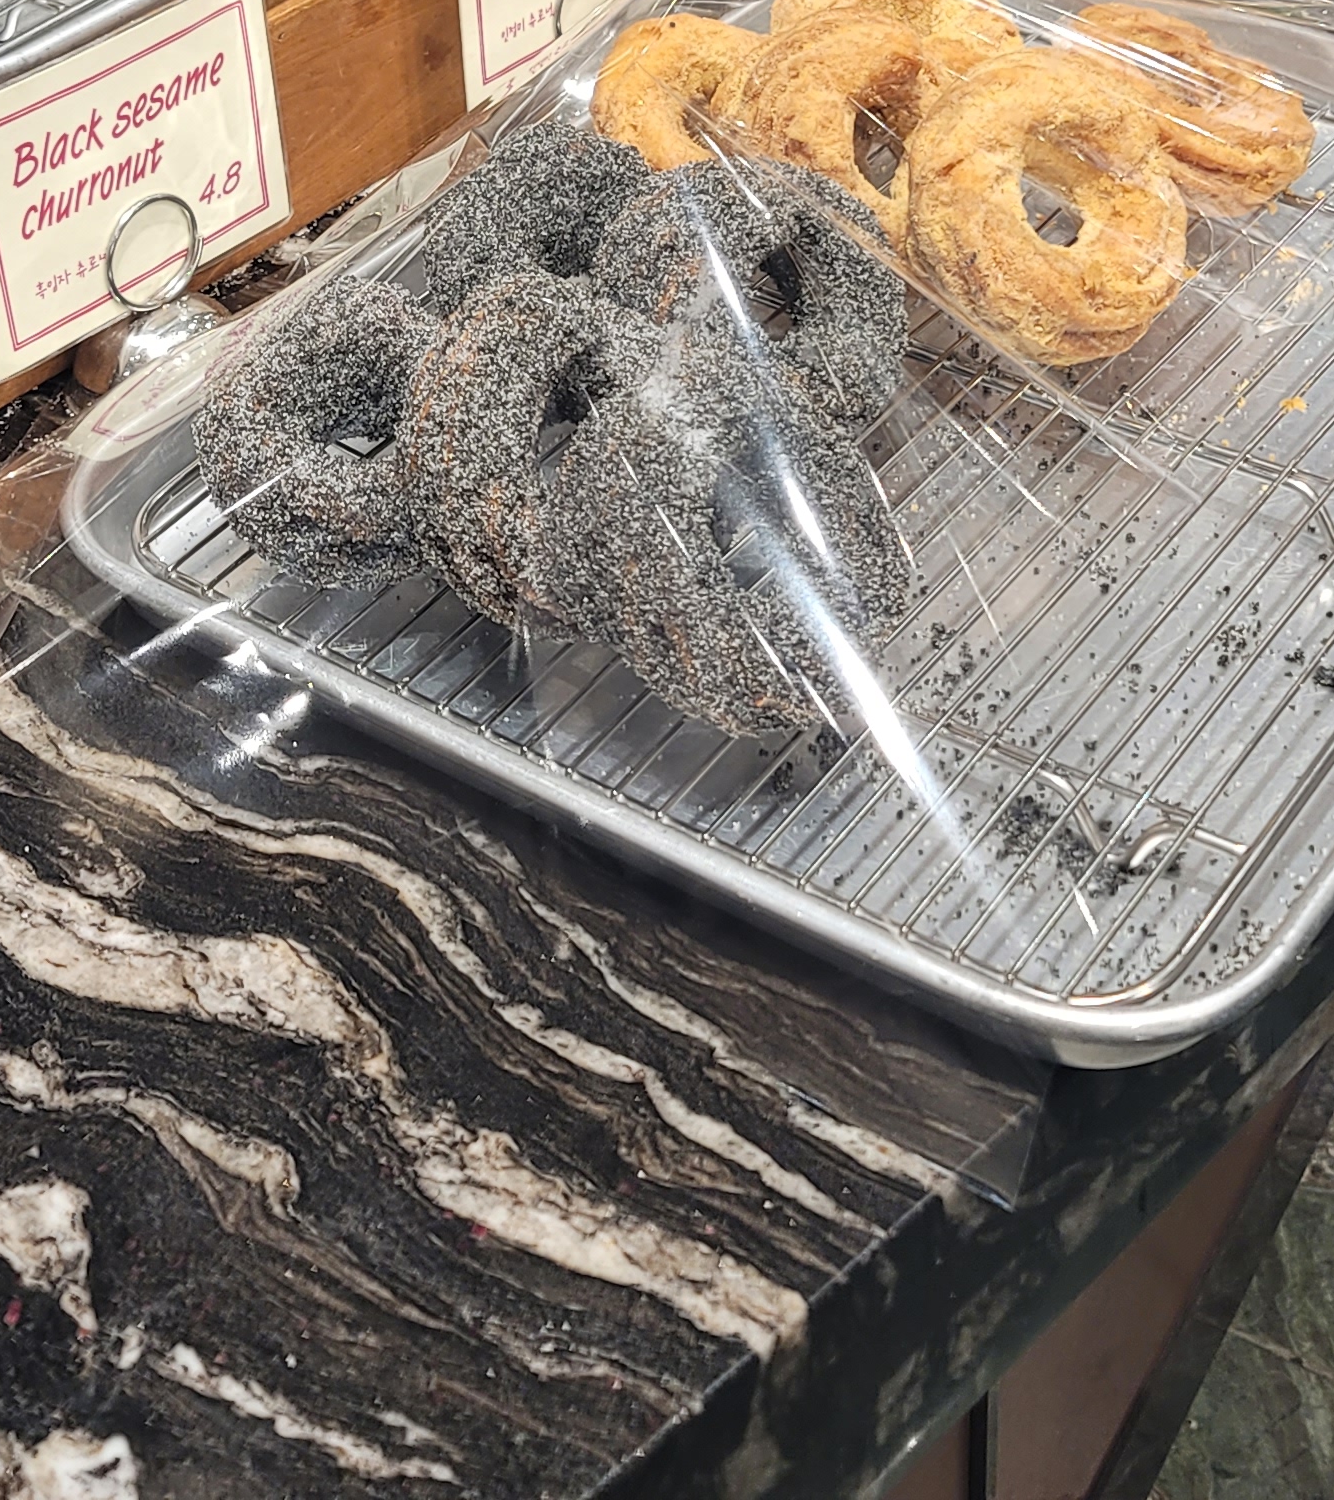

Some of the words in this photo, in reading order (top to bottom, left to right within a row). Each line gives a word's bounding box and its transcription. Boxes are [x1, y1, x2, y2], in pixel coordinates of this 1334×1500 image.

[13, 108, 104, 188] Black
[112, 52, 224, 139] sesame
[21, 137, 165, 240] churronut
[199, 160, 242, 205] 4.8
[35, 269, 72, 299] 흑임자
